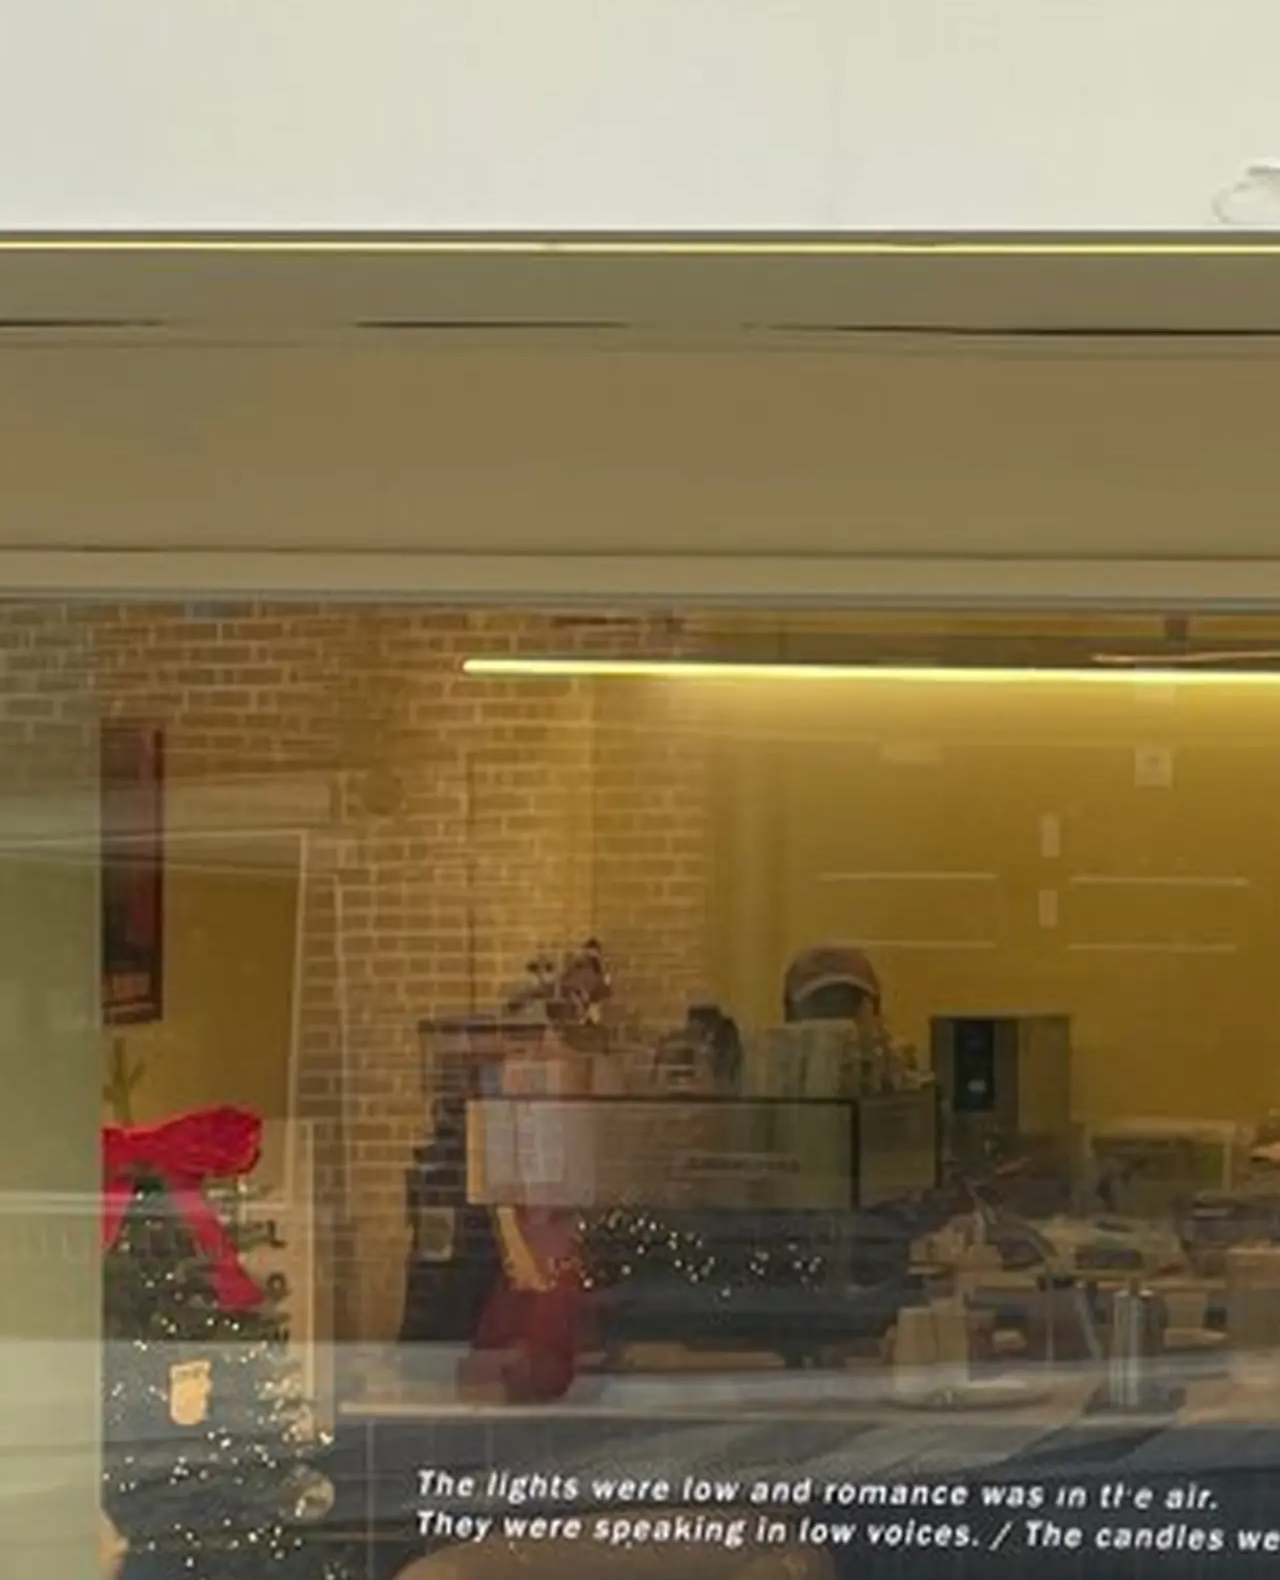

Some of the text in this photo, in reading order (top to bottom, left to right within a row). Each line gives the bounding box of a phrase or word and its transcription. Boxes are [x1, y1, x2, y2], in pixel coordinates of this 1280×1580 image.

[417, 1469, 475, 1499] The
[486, 1469, 580, 1504] lights
[592, 1477, 670, 1502] were
[683, 1474, 740, 1503] low
[750, 1477, 812, 1505] and
[823, 1482, 969, 1506] romance
[980, 1485, 1045, 1509] was
[1055, 1483, 1087, 1508] in
[1165, 1482, 1218, 1511] air.
[417, 1509, 491, 1543] They
[503, 1516, 582, 1540] were
[593, 1514, 746, 1548] speaking
[756, 1515, 787, 1543] in
[799, 1517, 855, 1545] low
[867, 1518, 980, 1547] voices.
[989, 1521, 1013, 1551] /
[1025, 1521, 1083, 1549] The
[1095, 1522, 1224, 1551] candles
